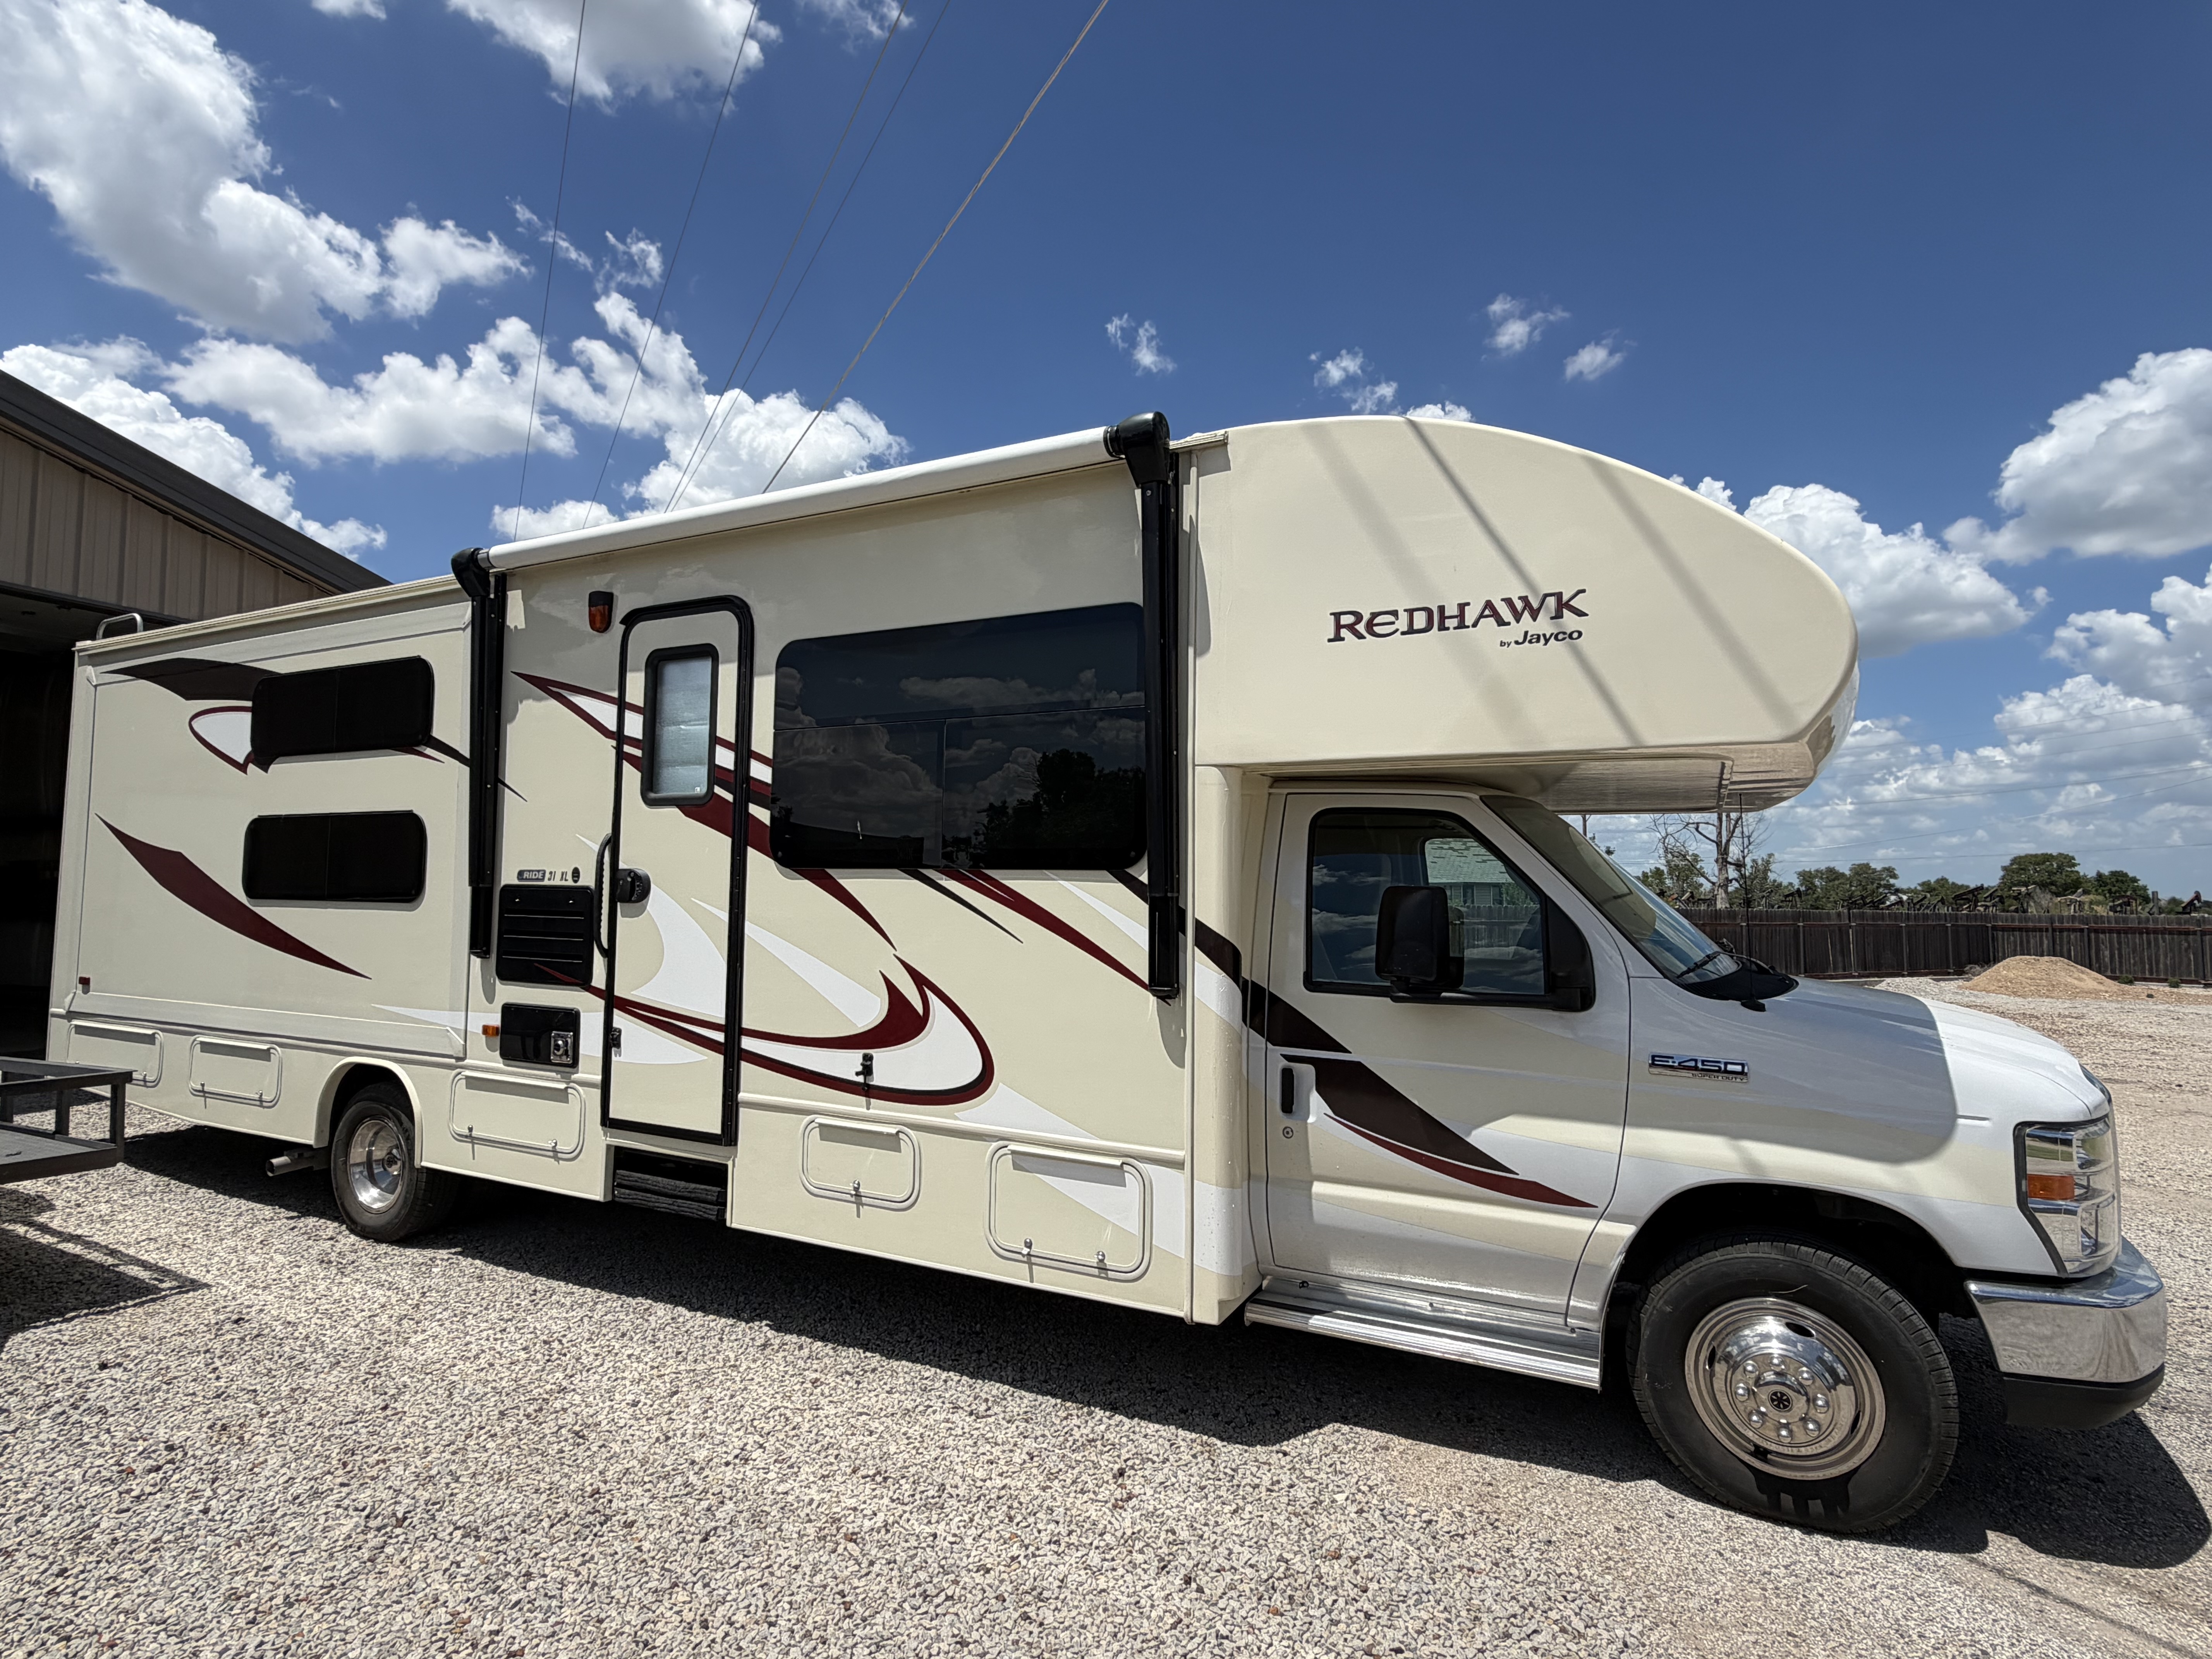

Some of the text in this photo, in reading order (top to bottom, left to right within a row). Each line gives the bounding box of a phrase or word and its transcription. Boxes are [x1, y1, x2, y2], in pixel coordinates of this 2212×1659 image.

[1327, 588, 1589, 643] REDHAWK
[1499, 630, 1583, 648] by Jayco
[548, 871, 556, 881] 31
[559, 871, 568, 881] XL
